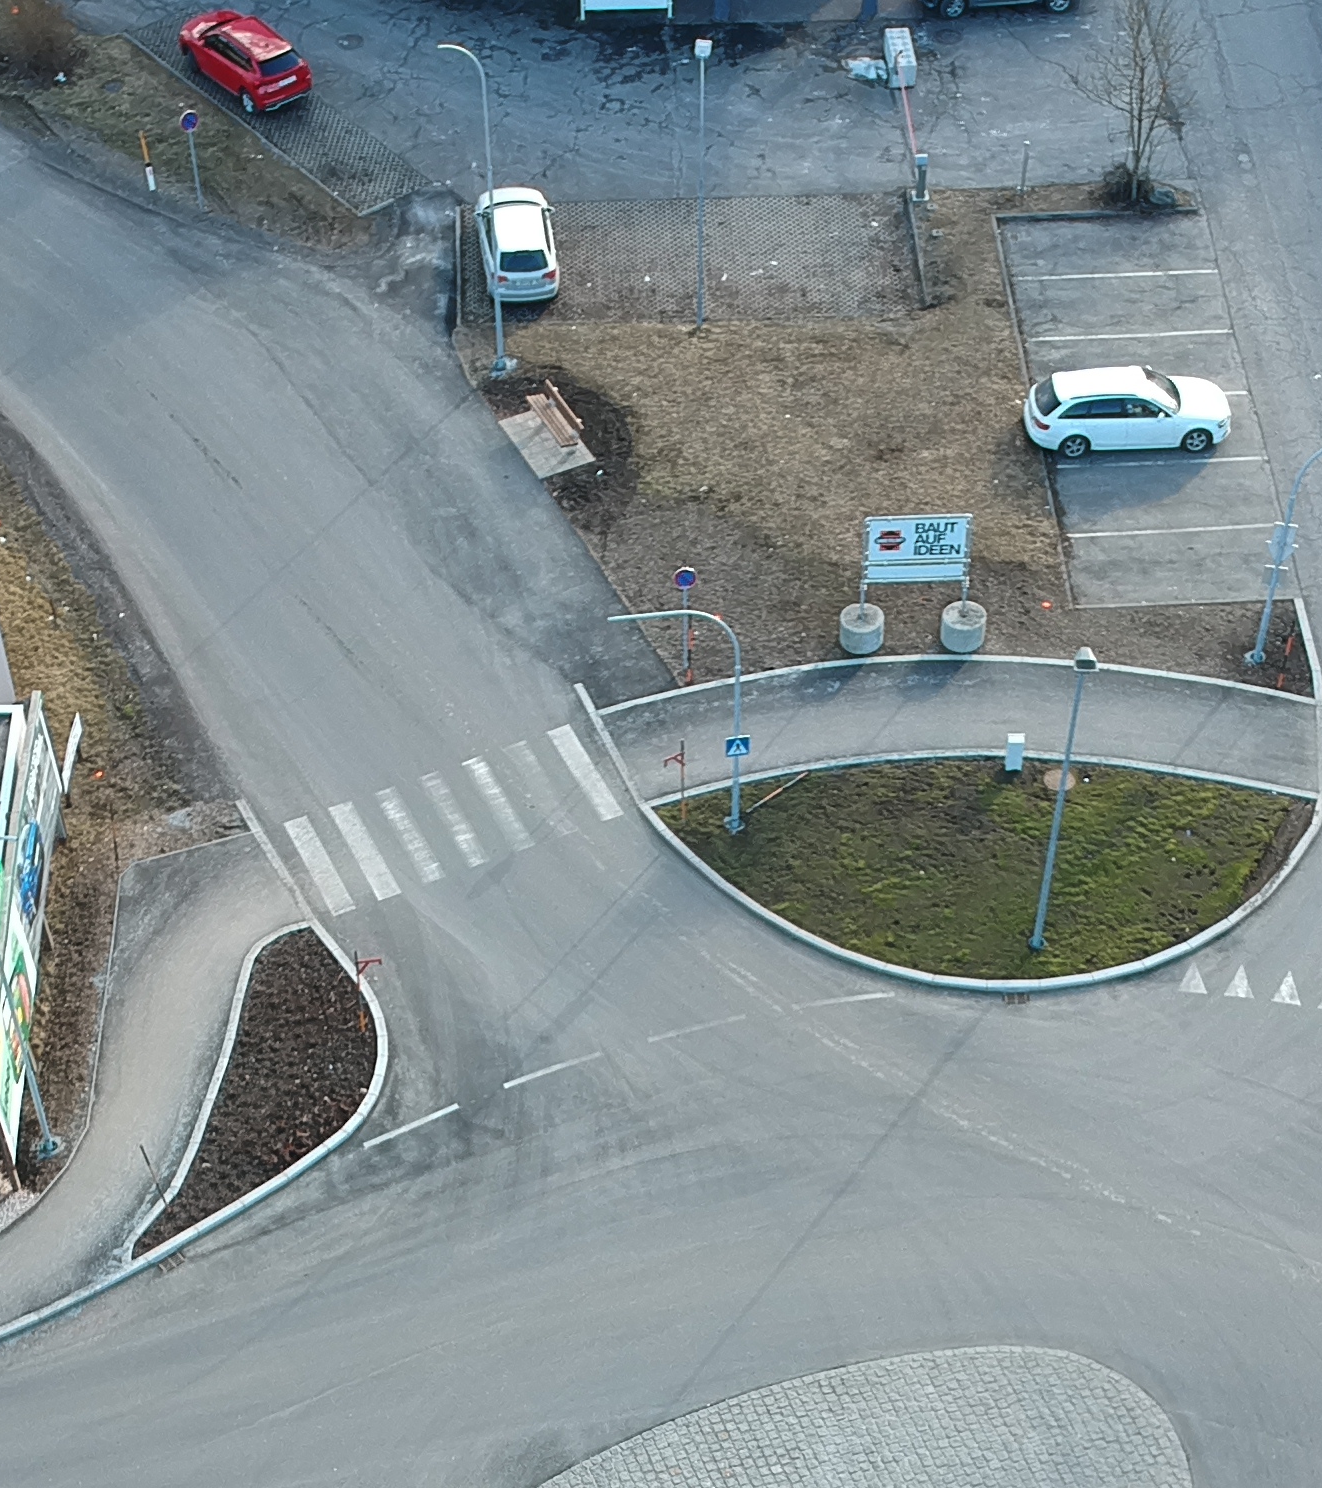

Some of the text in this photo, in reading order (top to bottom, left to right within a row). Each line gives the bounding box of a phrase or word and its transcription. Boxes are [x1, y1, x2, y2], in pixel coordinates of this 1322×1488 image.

[915, 522, 958, 534] BAUT
[915, 533, 946, 544] AUF
[913, 544, 961, 556] IDEEN
